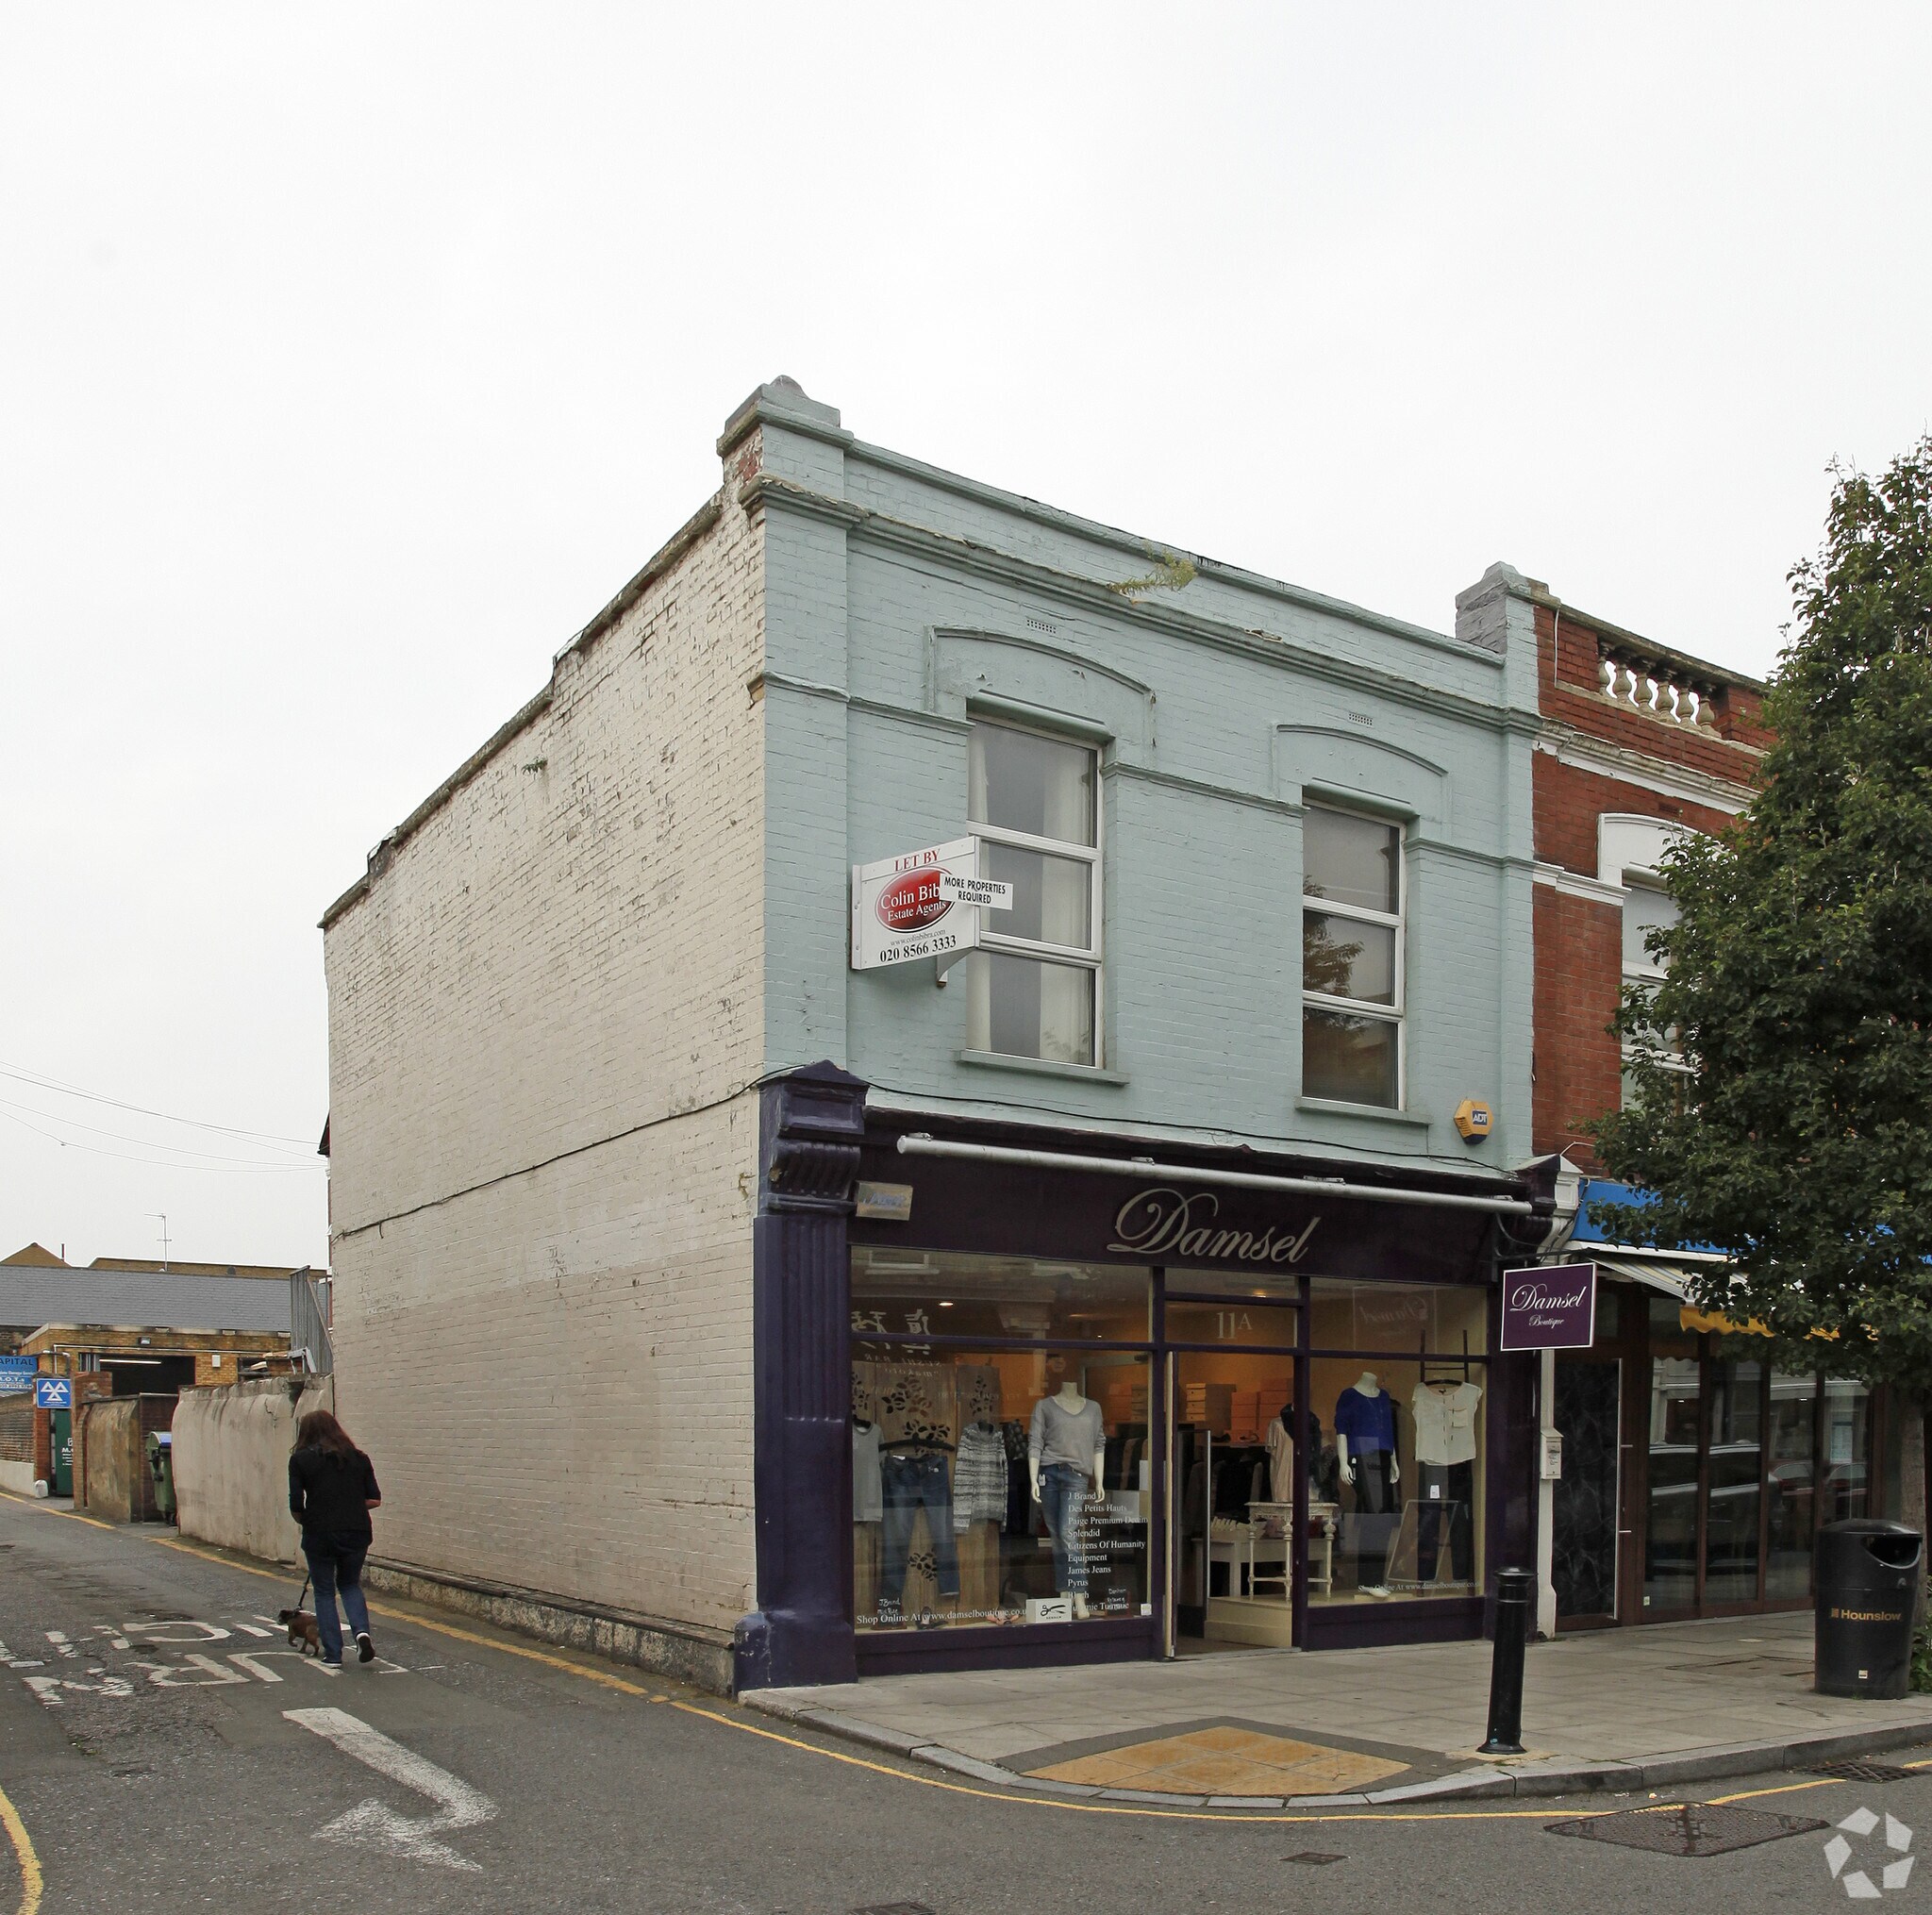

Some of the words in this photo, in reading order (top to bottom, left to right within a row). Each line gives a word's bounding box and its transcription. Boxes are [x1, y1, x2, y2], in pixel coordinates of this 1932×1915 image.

[894, 855, 920, 872] LET
[924, 848, 941, 864] BY
[944, 876, 964, 889] MORE
[967, 880, 1006, 894] PROPERTIES
[880, 890, 914, 909] Colin
[919, 883, 941, 901] Bib
[958, 891, 991, 905] REQUIRED
[888, 908, 914, 922] Estate
[916, 901, 946, 917] Agents
[880, 947, 900, 962] 020
[903, 943, 929, 958] 8566
[932, 935, 957, 952] 3333
[1473, 1113, 1488, 1123] ADT
[1107, 1188, 1321, 1263] Damsel
[1509, 1283, 1587, 1311] Damsel
[1528, 1314, 1564, 1329] Boutique
[1074, 1491, 1096, 1500] Brand
[1084, 1504, 1105, 1512] Petits
[1068, 1517, 1089, 1526] Paige
[1090, 1516, 1124, 1524] Premium
[1068, 1529, 1101, 1539] Splendid
[1068, 1541, 1098, 1550] Citizens
[1110, 1540, 1146, 1549] Humanity
[1068, 1554, 1108, 1563] Equipment
[1068, 1566, 1090, 1574] James
[1068, 1578, 1089, 1588] Pyrus
[1068, 1590, 1090, 1599] Blh
[856, 1614, 878, 1625] Shop
[880, 1613, 908, 1623] Online
[910, 1612, 921, 1622] At
[923, 1607, 1027, 1621] www.damselboutique.co.u
[1840, 1608, 1902, 1621] Hounslow
